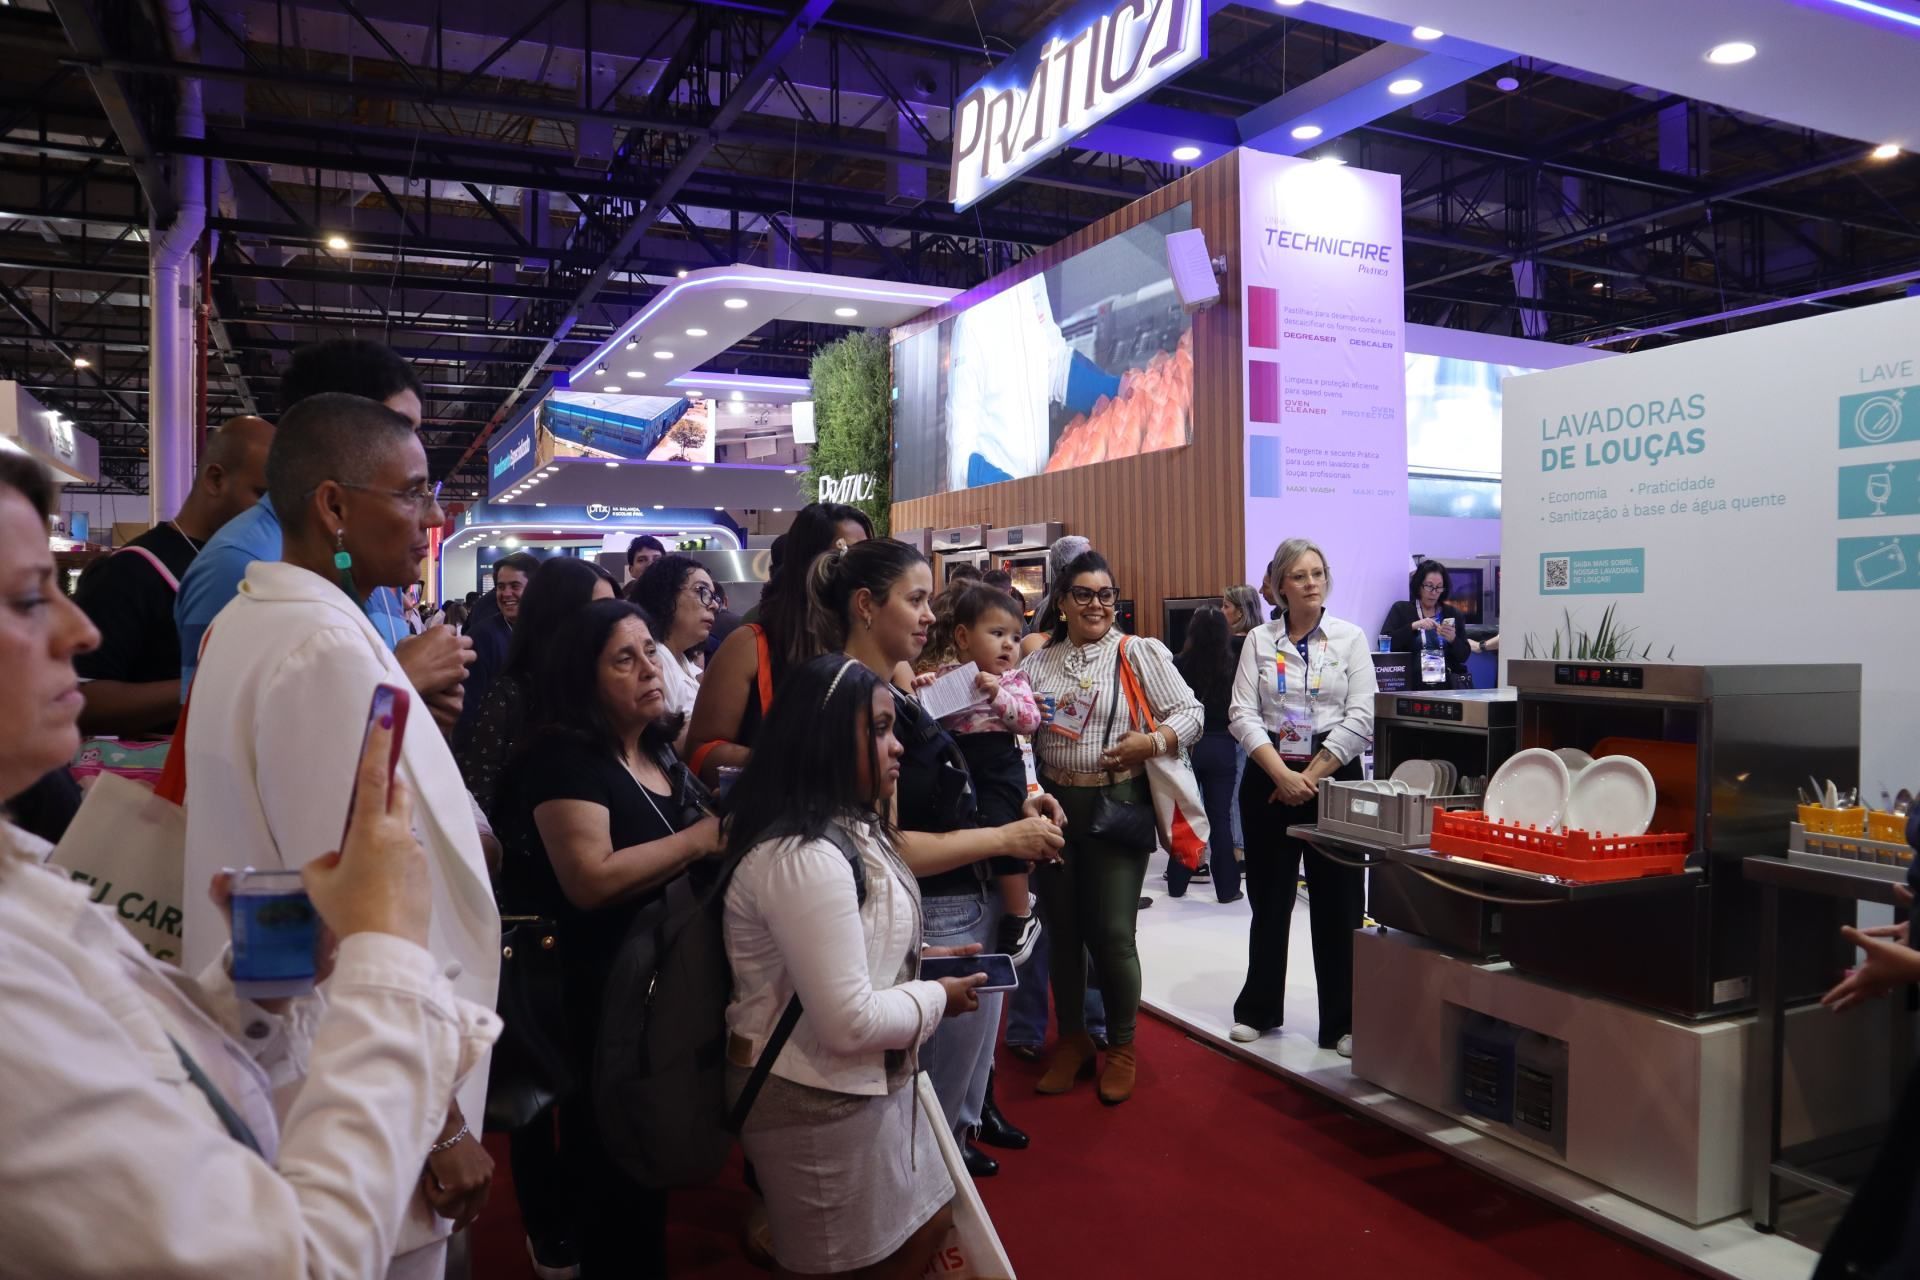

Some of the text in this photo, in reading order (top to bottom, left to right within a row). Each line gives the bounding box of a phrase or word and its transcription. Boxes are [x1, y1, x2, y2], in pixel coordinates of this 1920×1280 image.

[1265, 228, 1393, 263] TECHNICARE
[1315, 311, 1330, 319] para
[1358, 326, 1396, 337] combinados
[1283, 331, 1393, 349] DEGREASER DESCALER
[1858, 359, 1914, 384] LAVE
[1285, 376, 1313, 386] Limpeza
[1320, 378, 1350, 389] proteção
[1351, 382, 1380, 391] eficiente
[1285, 387, 1343, 399] para speed ovens
[1285, 399, 1310, 407] OVEN
[1285, 406, 1327, 416] CLEANER
[1341, 410, 1395, 420] PROTECTOR
[1542, 393, 1706, 442] LAVADORAS
[1285, 446, 1322, 457] Detergente
[1541, 427, 1706, 472] DE LOUÇAS
[1285, 458, 1301, 467] para
[1329, 460, 1359, 469] lavadoras
[1286, 469, 1308, 478] louças
[1310, 486, 1336, 494] WASH
[1638, 475, 1716, 496] Praticidade
[1548, 486, 1608, 504] Economia
[1548, 506, 1618, 523] Sanitização
[1633, 503, 1666, 517] base
[1670, 500, 1688, 514] de
[1692, 497, 1727, 515] água
[1730, 493, 1787, 512] quente
[1600, 566, 1640, 575] LAVADORAS
[117, 891, 182, 938] CAR
